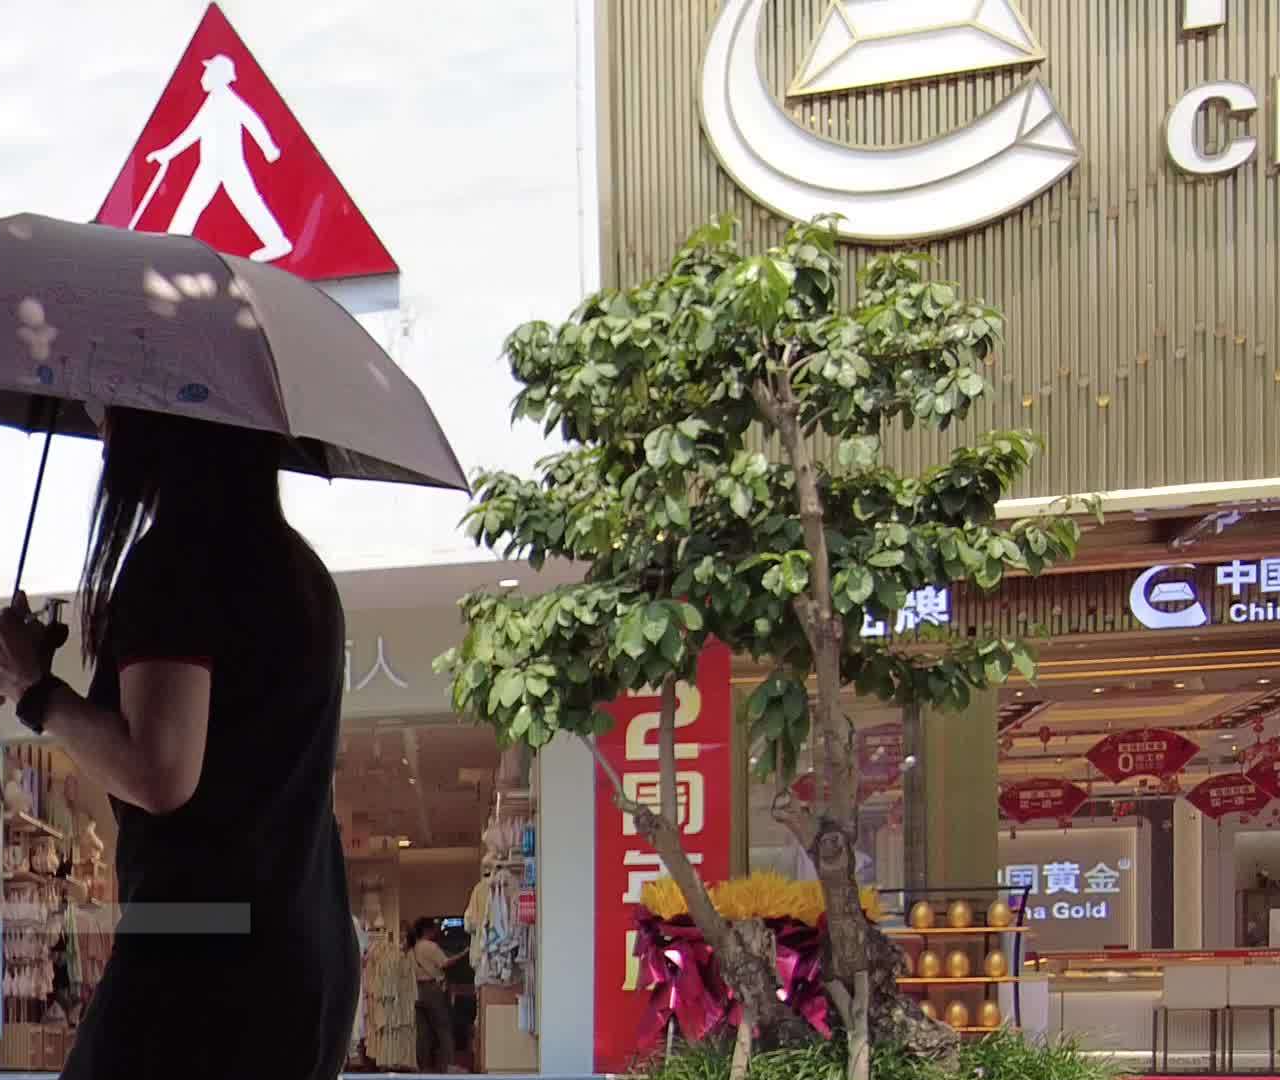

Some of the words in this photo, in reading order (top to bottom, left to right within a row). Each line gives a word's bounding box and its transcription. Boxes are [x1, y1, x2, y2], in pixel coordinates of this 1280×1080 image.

[1168, 80, 1280, 173] C
[1229, 602, 1280, 622] Chi
[345, 635, 409, 693] 人
[997, 861, 1122, 896] 国黄金
[1052, 900, 1108, 920] Gold
